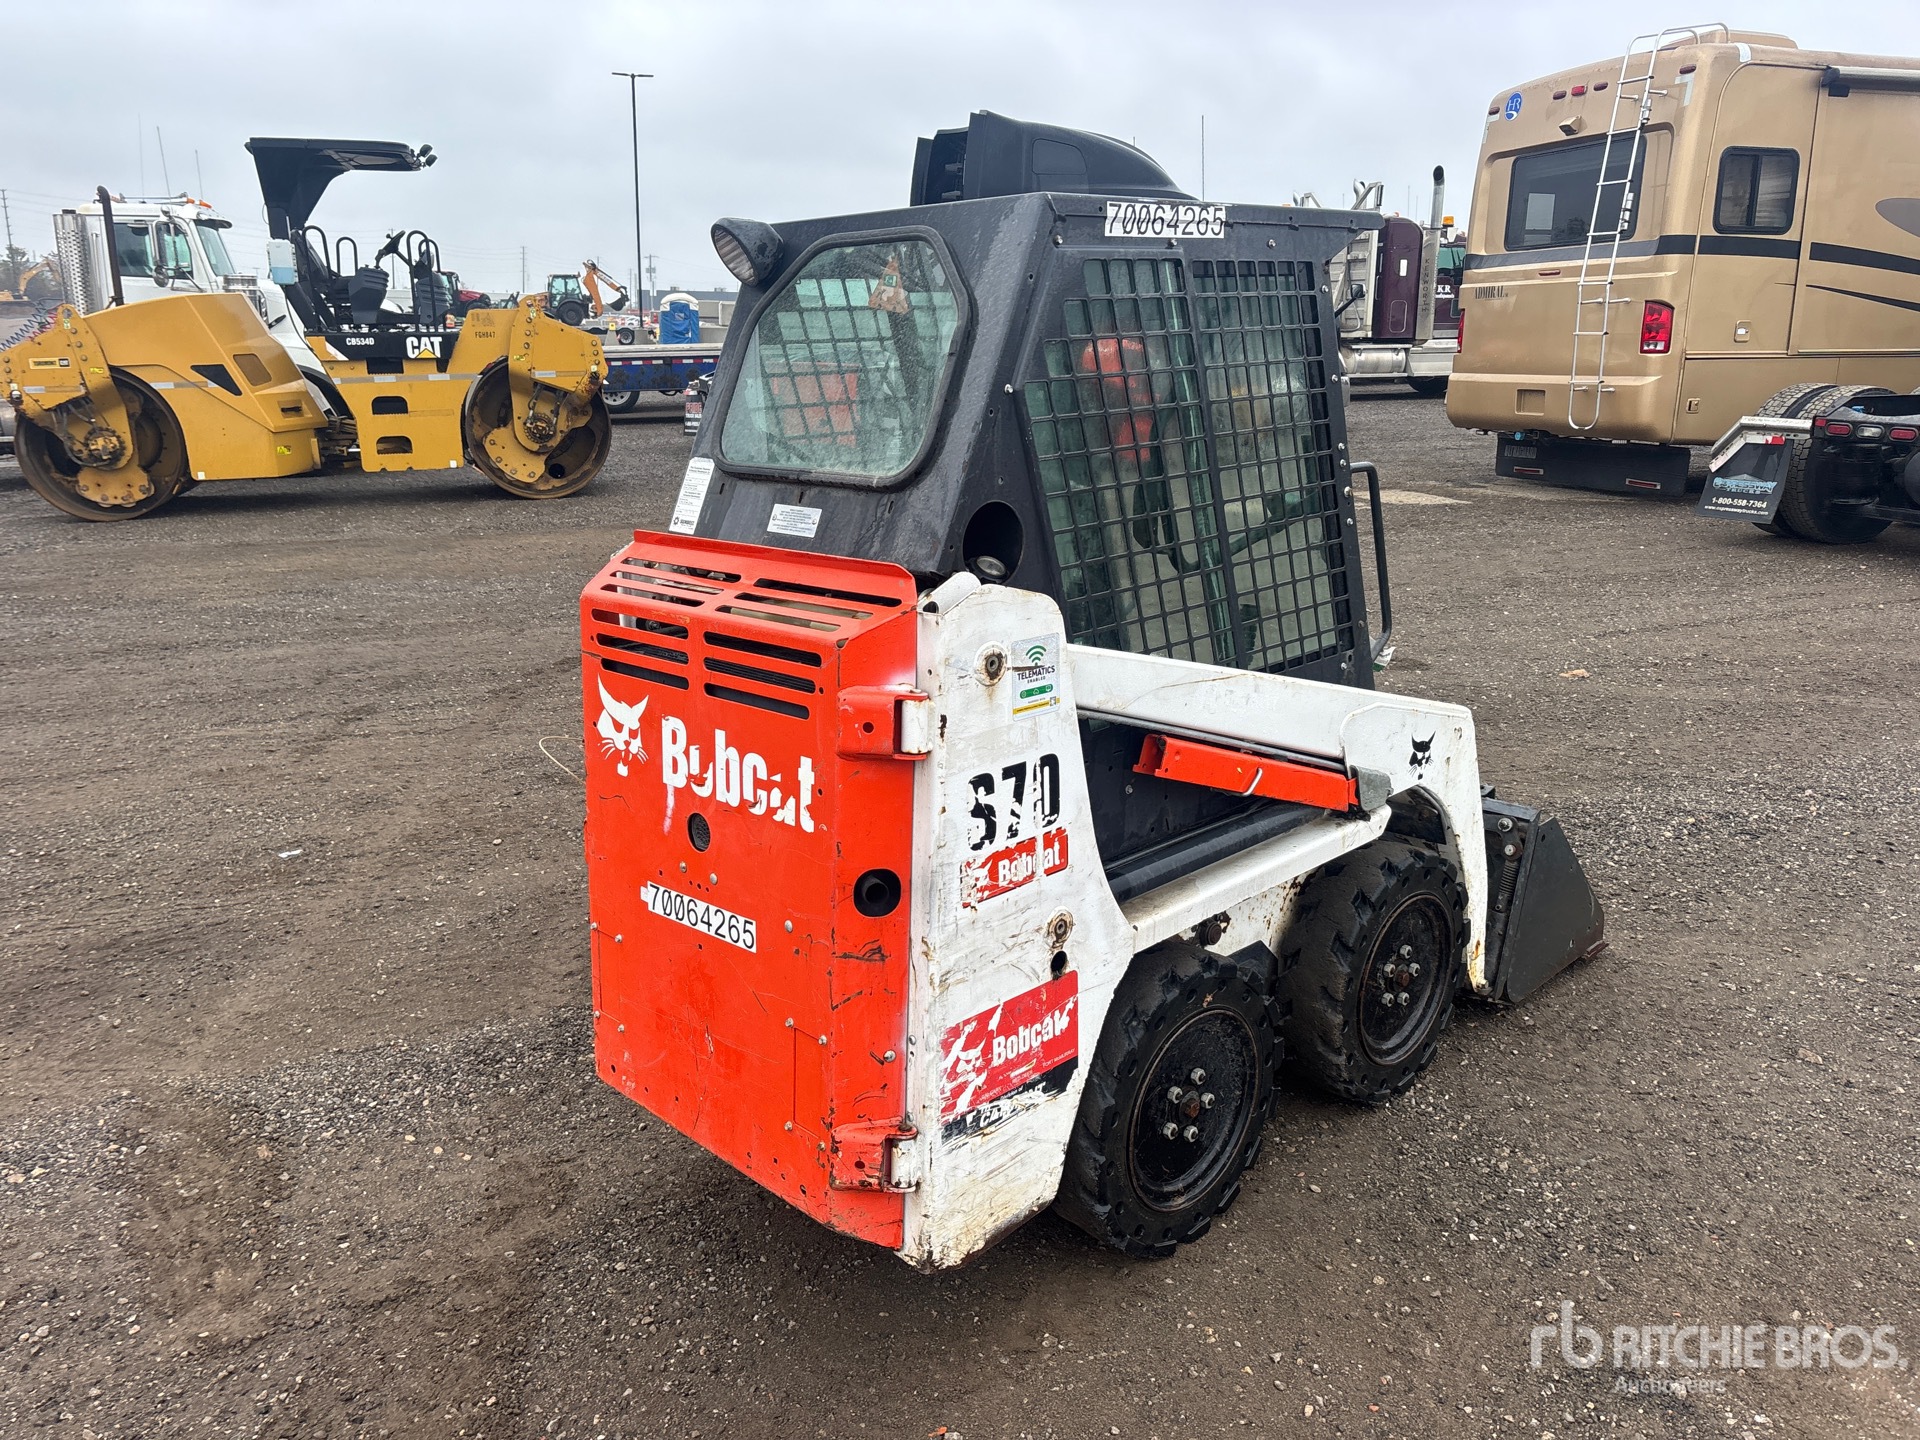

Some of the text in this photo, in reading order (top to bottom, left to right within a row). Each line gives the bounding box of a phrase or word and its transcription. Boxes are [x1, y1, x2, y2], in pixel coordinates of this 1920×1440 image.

[1108, 202, 1224, 236] 70064265
[1421, 258, 1430, 313] KENWORTH
[1437, 284, 1451, 293] KR
[346, 337, 375, 346] CB534D
[406, 336, 442, 358] CAT
[1712, 496, 1767, 509] 1-800-558-7364
[1017, 665, 1056, 680] TELEMATICS
[998, 838, 1060, 885] Bobat
[648, 883, 756, 950] 70064265
